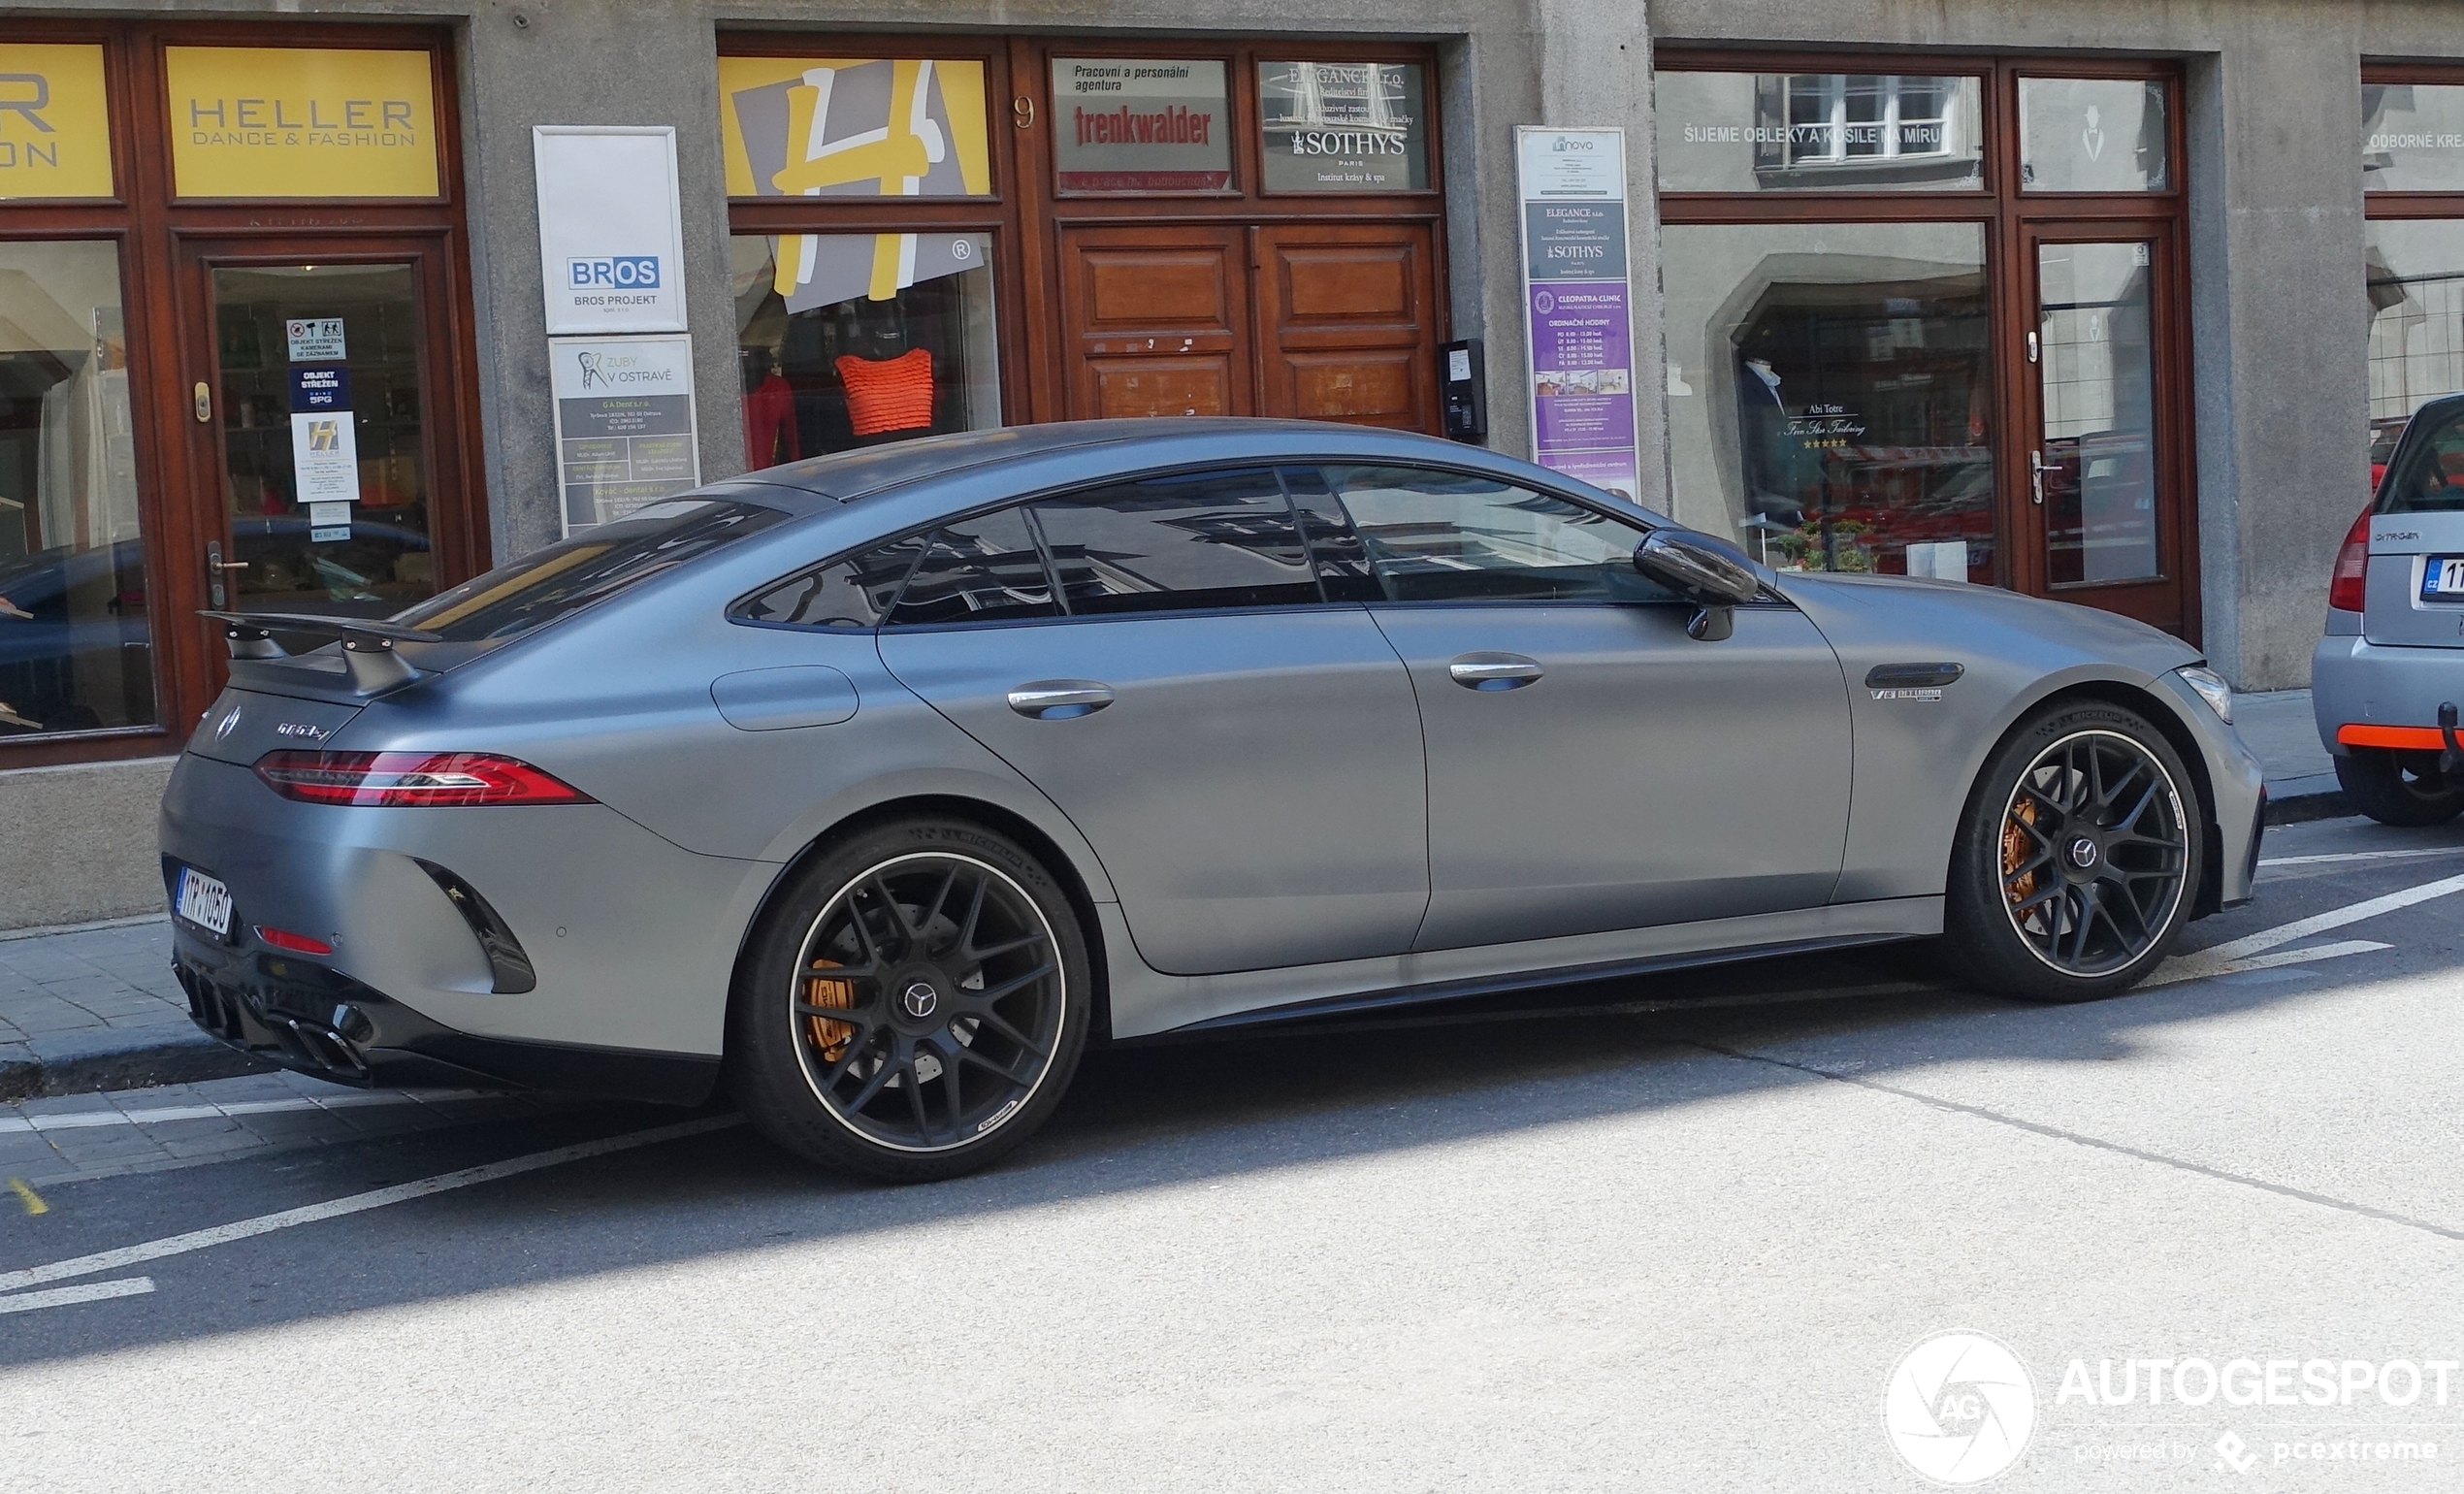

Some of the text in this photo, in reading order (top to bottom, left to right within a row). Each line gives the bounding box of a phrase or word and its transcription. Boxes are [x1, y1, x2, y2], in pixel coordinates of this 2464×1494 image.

[1075, 65, 1189, 80] Pracovní a personální
[1075, 80, 1121, 93] agentura
[190, 99, 414, 129] HELLER
[1014, 95, 1034, 128] 9
[1074, 105, 1211, 146] trenkwalder
[193, 132, 414, 146] DANCE & FASHION
[1684, 123, 1739, 143] ŠIJEME
[1743, 127, 1804, 144] OBLEKY
[1808, 128, 1820, 143] A
[1880, 128, 1901, 143] NA
[1904, 124, 1941, 144] MÍRU
[2370, 131, 2464, 147] ODBORNÉ KRE
[1307, 132, 1405, 155] SOTHYS
[1373, 175, 1384, 183] spa
[1546, 209, 1591, 217] ELEGANCE
[1554, 245, 1604, 258] SOTHYS
[572, 261, 656, 284] BROS
[574, 295, 657, 306] BROS PROJEKT
[1548, 318, 1584, 327] ORDINAČNÍ
[607, 357, 637, 367] ZUBY
[303, 371, 335, 379] OBJEKT
[607, 369, 672, 382] V OSTRAVĚ
[301, 379, 339, 388] STŘEŽEN
[1809, 405, 1823, 413] Abi
